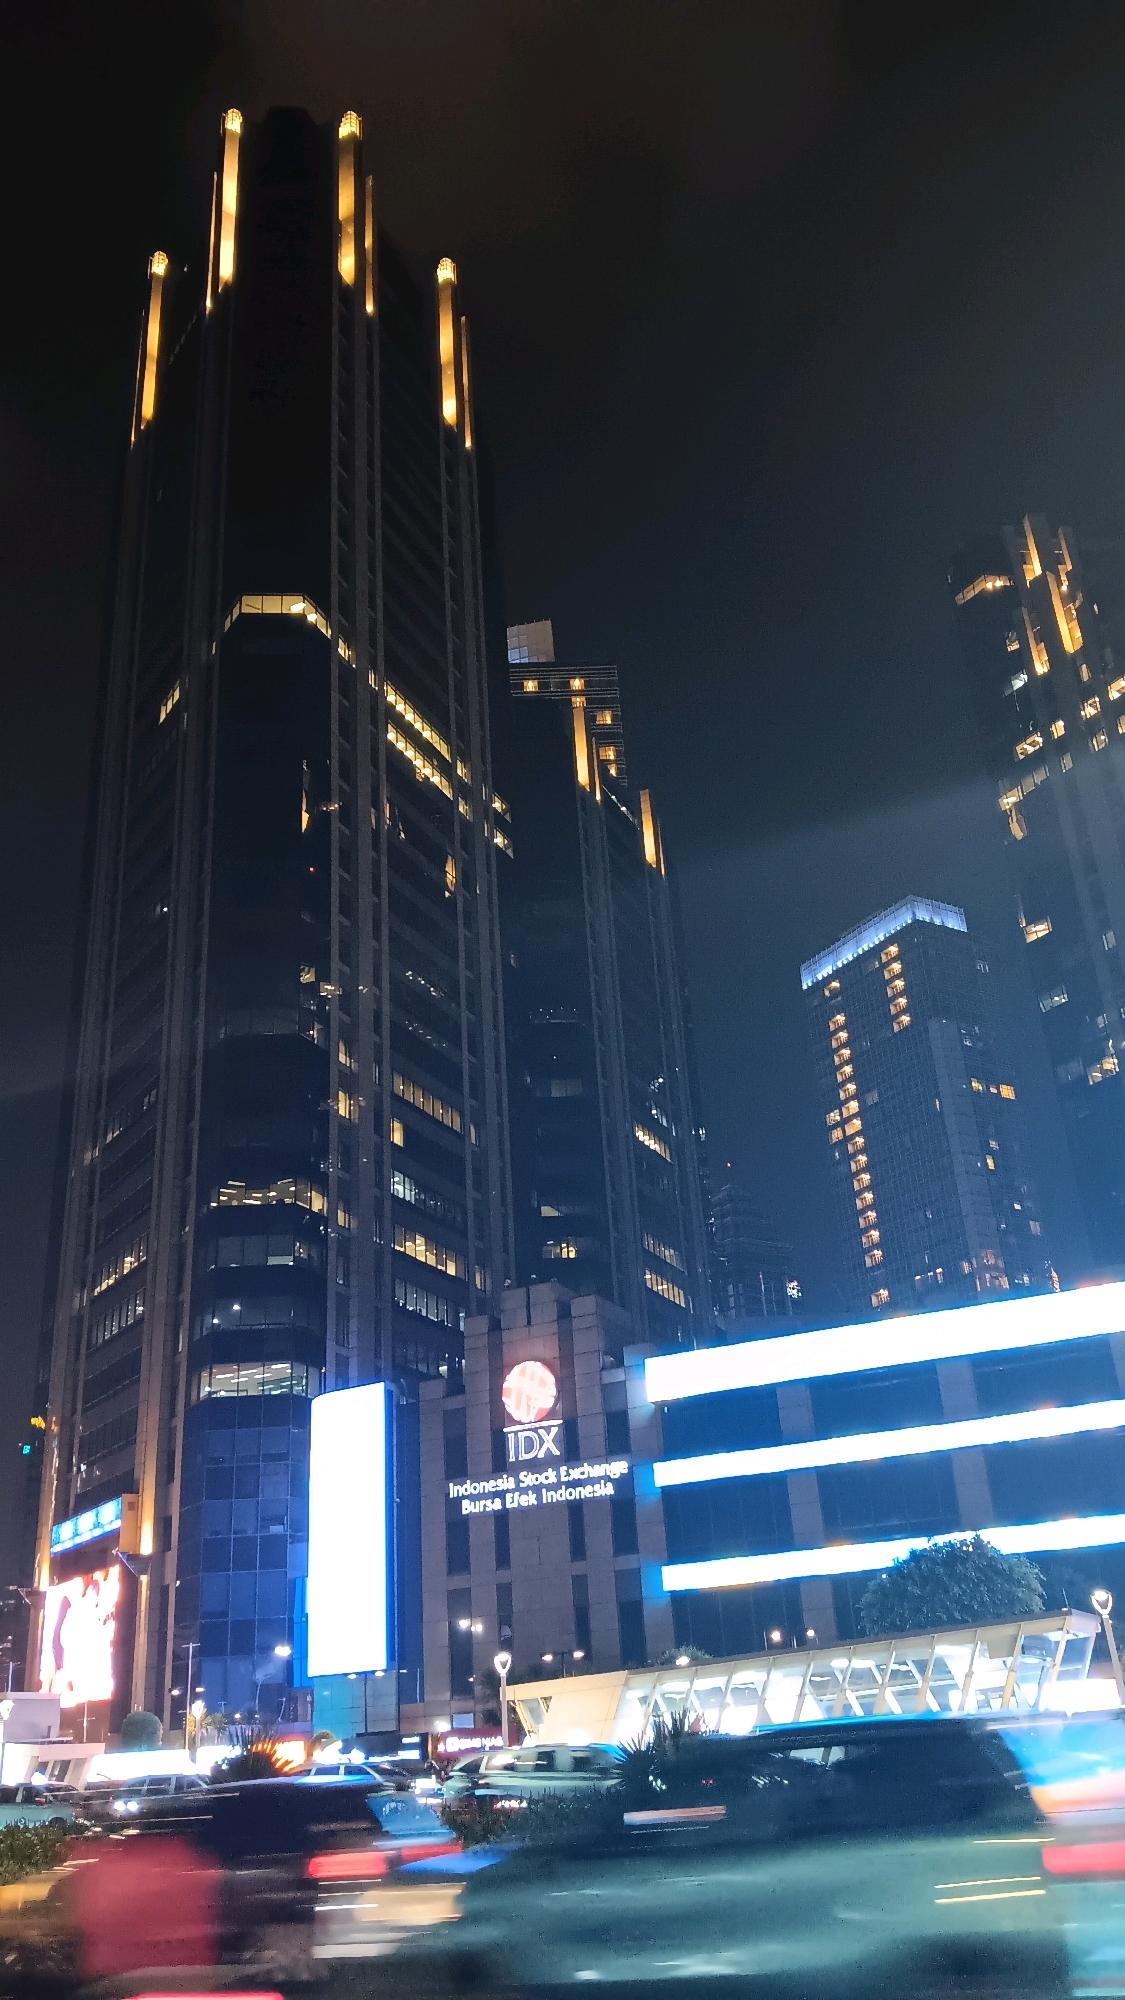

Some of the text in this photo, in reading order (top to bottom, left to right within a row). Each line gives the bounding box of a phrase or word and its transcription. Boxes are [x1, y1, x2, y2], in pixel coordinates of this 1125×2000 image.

[508, 1426, 561, 1462] IDX
[449, 1460, 629, 1498] Indonesia Stock Exchange
[461, 1480, 614, 1514] Bursa Efek Indonesia
